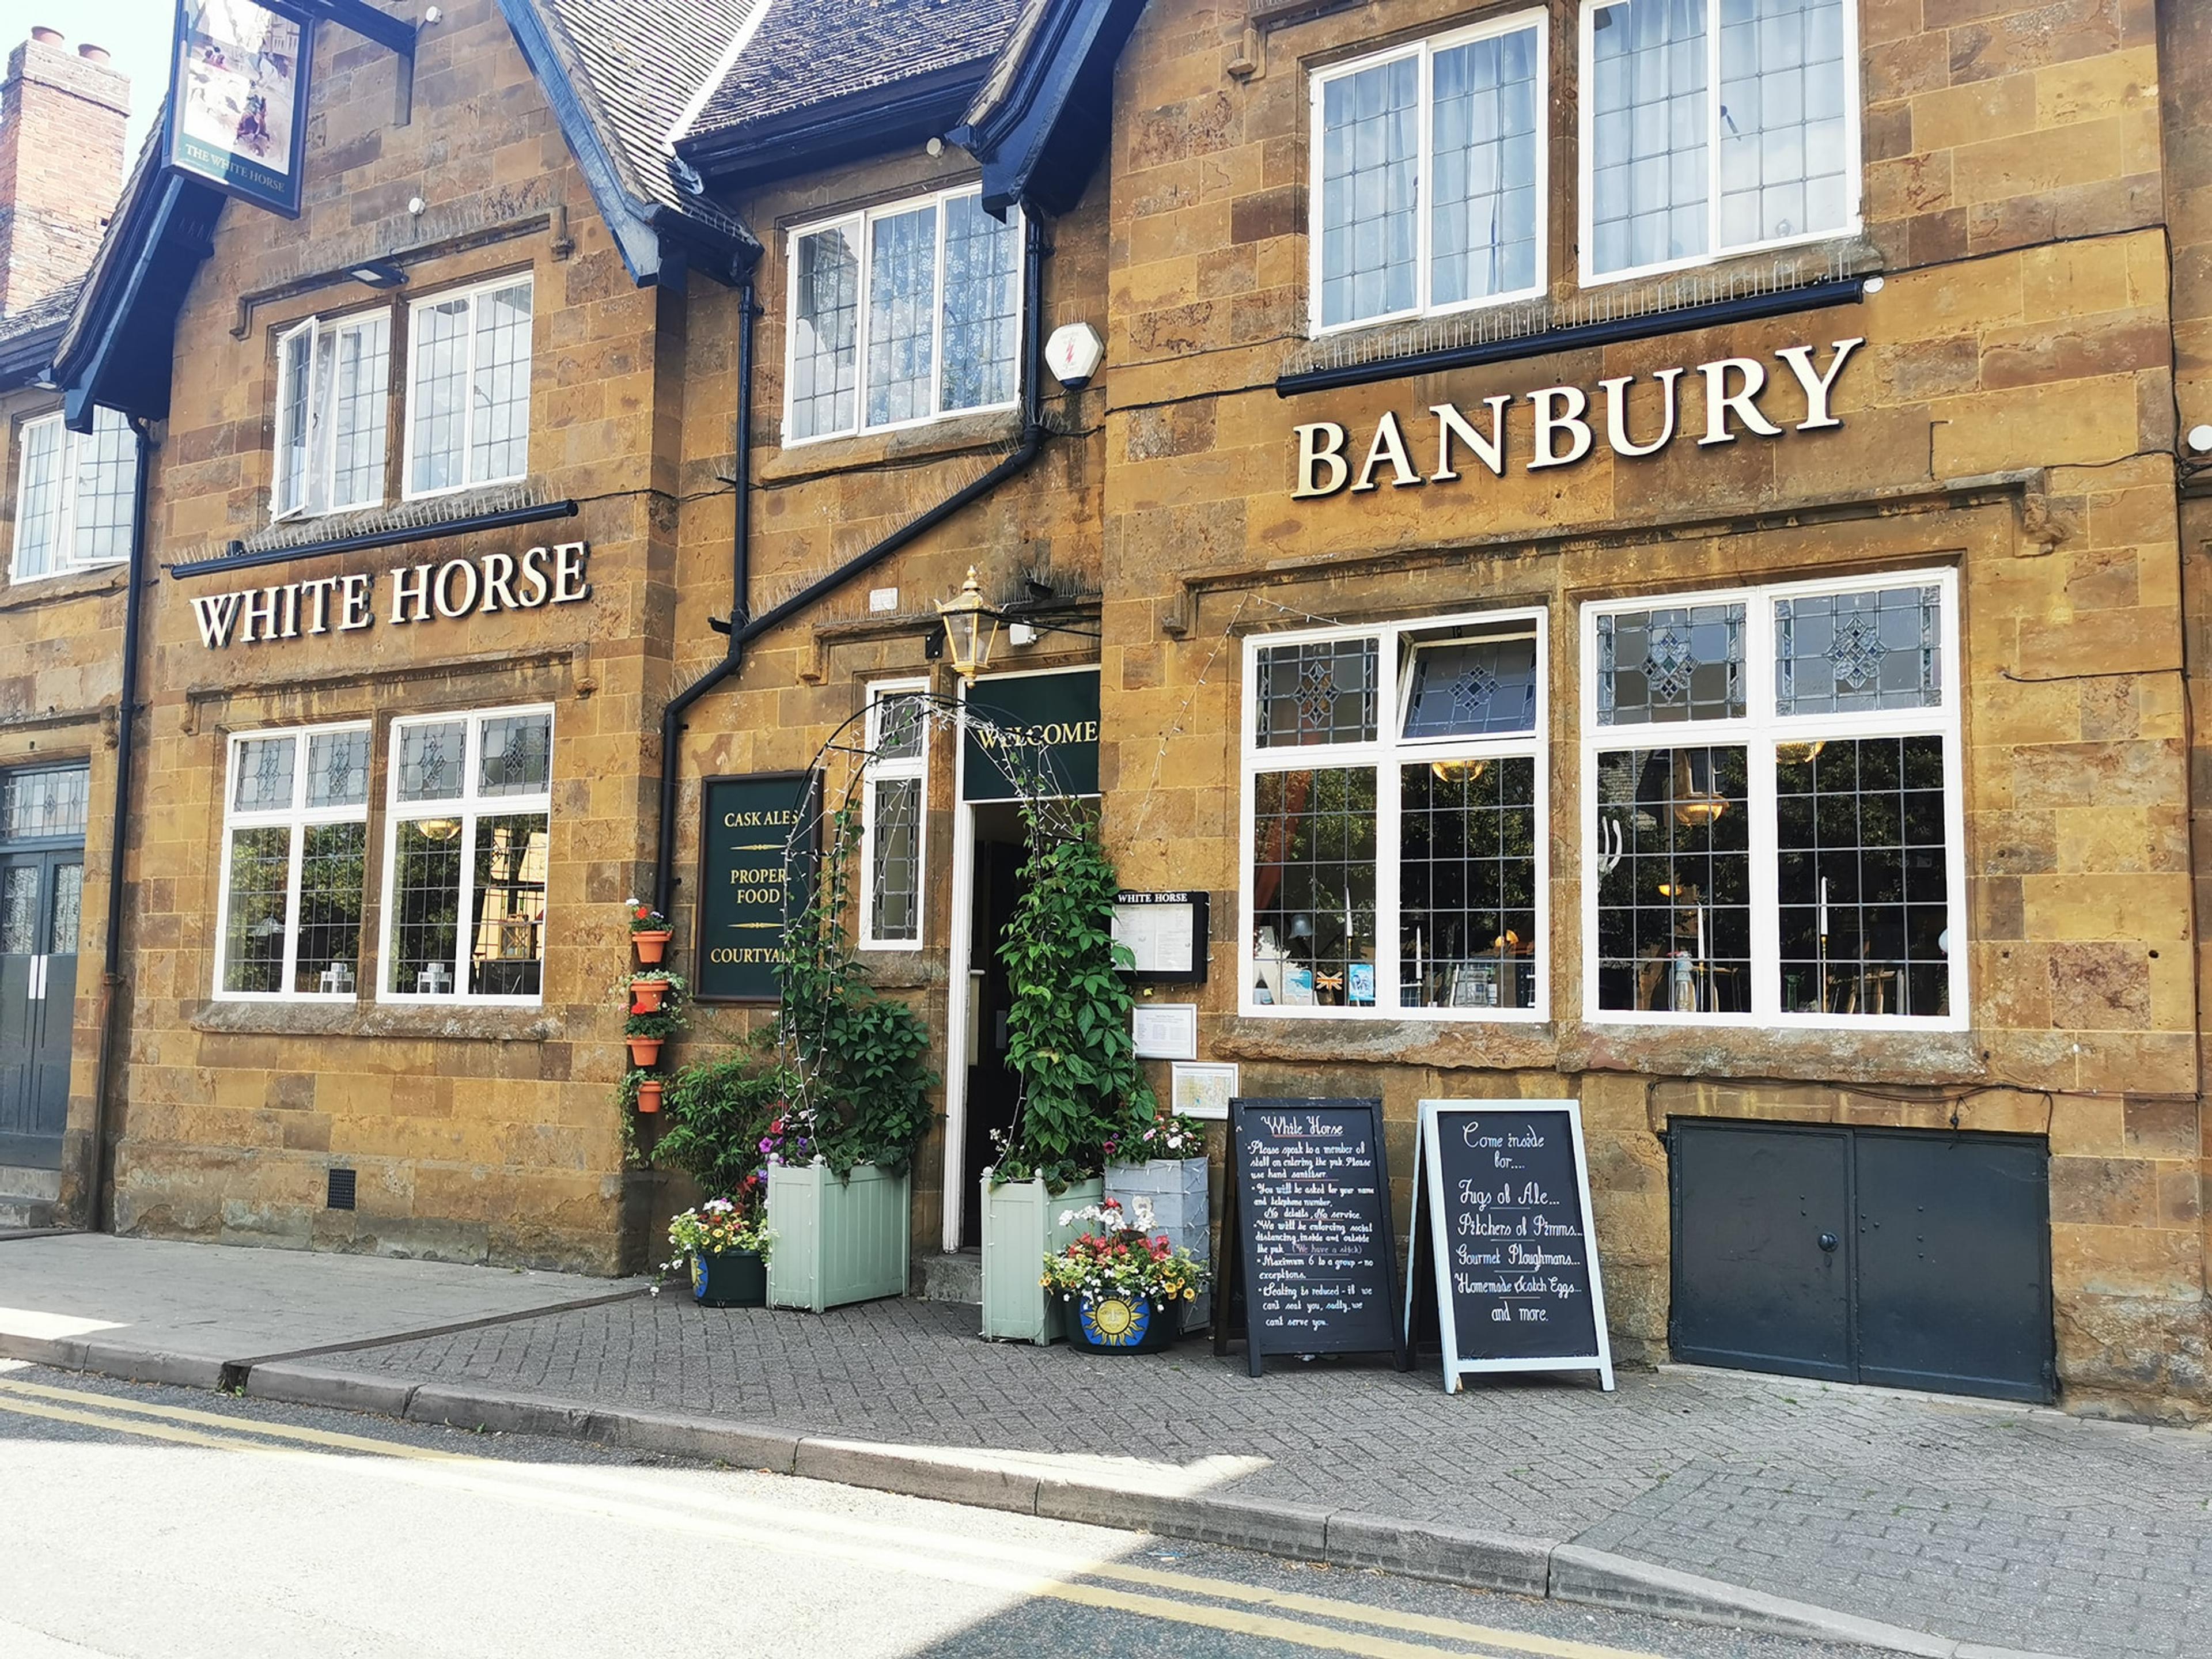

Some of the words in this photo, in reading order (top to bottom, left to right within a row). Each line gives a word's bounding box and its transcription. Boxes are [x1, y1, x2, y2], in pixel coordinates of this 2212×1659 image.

[185, 144, 209, 162] THE
[210, 154, 248, 178] WHITE
[249, 170, 285, 192] HORSE
[1291, 337, 1866, 501] BANBURY
[190, 575, 372, 649] WHITE
[389, 541, 590, 624] HORSE
[978, 721, 1098, 749] WELCOME
[724, 812, 762, 827] CASK
[763, 810, 799, 825] ALES
[730, 868, 786, 884] PROPER
[737, 889, 780, 904] FOOD
[1118, 893, 1152, 903] WHITE
[1154, 893, 1188, 902] HORSE
[1260, 1116, 1303, 1135] White
[1306, 1115, 1343, 1135] Horse
[1462, 1121, 1503, 1147] Come
[1508, 1124, 1544, 1147] inside
[1249, 1139, 1279, 1154] Please
[1282, 1141, 1303, 1157] speak
[1306, 1142, 1313, 1153] to
[1323, 1142, 1353, 1153] member
[1355, 1141, 1365, 1154] of
[1250, 1156, 1269, 1167] staff
[1283, 1157, 1313, 1172] entering
[1316, 1156, 1326, 1166] the
[1346, 1157, 1371, 1166] Please
[1268, 1168, 1287, 1178] hand
[1256, 1183, 1273, 1194] You
[1276, 1183, 1291, 1194] will
[1294, 1183, 1302, 1194] be
[1305, 1183, 1325, 1194] asked
[1328, 1183, 1338, 1194] for
[1340, 1187, 1354, 1197] your
[1458, 1179, 1491, 1210] Jugs
[1498, 1183, 1510, 1203] of
[1518, 1181, 1560, 1205] Ale...
[1253, 1196, 1267, 1206] and
[1271, 1196, 1302, 1207] telephone
[1264, 1207, 1278, 1218] No
[1314, 1207, 1328, 1218] No
[1256, 1219, 1274, 1230] We
[1278, 1219, 1295, 1230] will
[1298, 1221, 1306, 1230] be
[1309, 1219, 1346, 1235] enforcing
[1350, 1222, 1373, 1232] social
[1457, 1212, 1512, 1236] Pitchers
[1516, 1216, 1527, 1236] of
[1300, 1233, 1323, 1242] inside
[1325, 1234, 1339, 1242] and
[1343, 1234, 1369, 1243] outside
[1257, 1243, 1267, 1253] the
[1291, 1243, 1308, 1253] (We
[1311, 1244, 1328, 1253] have
[1339, 1244, 1362, 1254] stick)
[1456, 1243, 1501, 1265] Gourmet
[1262, 1255, 1304, 1266] Maximum
[1308, 1255, 1314, 1265] 6
[1318, 1256, 1325, 1266] to
[1335, 1259, 1355, 1270] group
[1259, 1268, 1306, 1281] exceptions.
[1263, 1282, 1297, 1300] Seating
[1300, 1286, 1309, 1296] is
[1312, 1283, 1339, 1296] reduced
[1347, 1284, 1355, 1296] if
[1454, 1272, 1512, 1294] Homemade
[1514, 1275, 1547, 1294] Scotch
[1285, 1300, 1302, 1310] seat
[1491, 1300, 1511, 1321] and
[1519, 1308, 1549, 1321] more.
